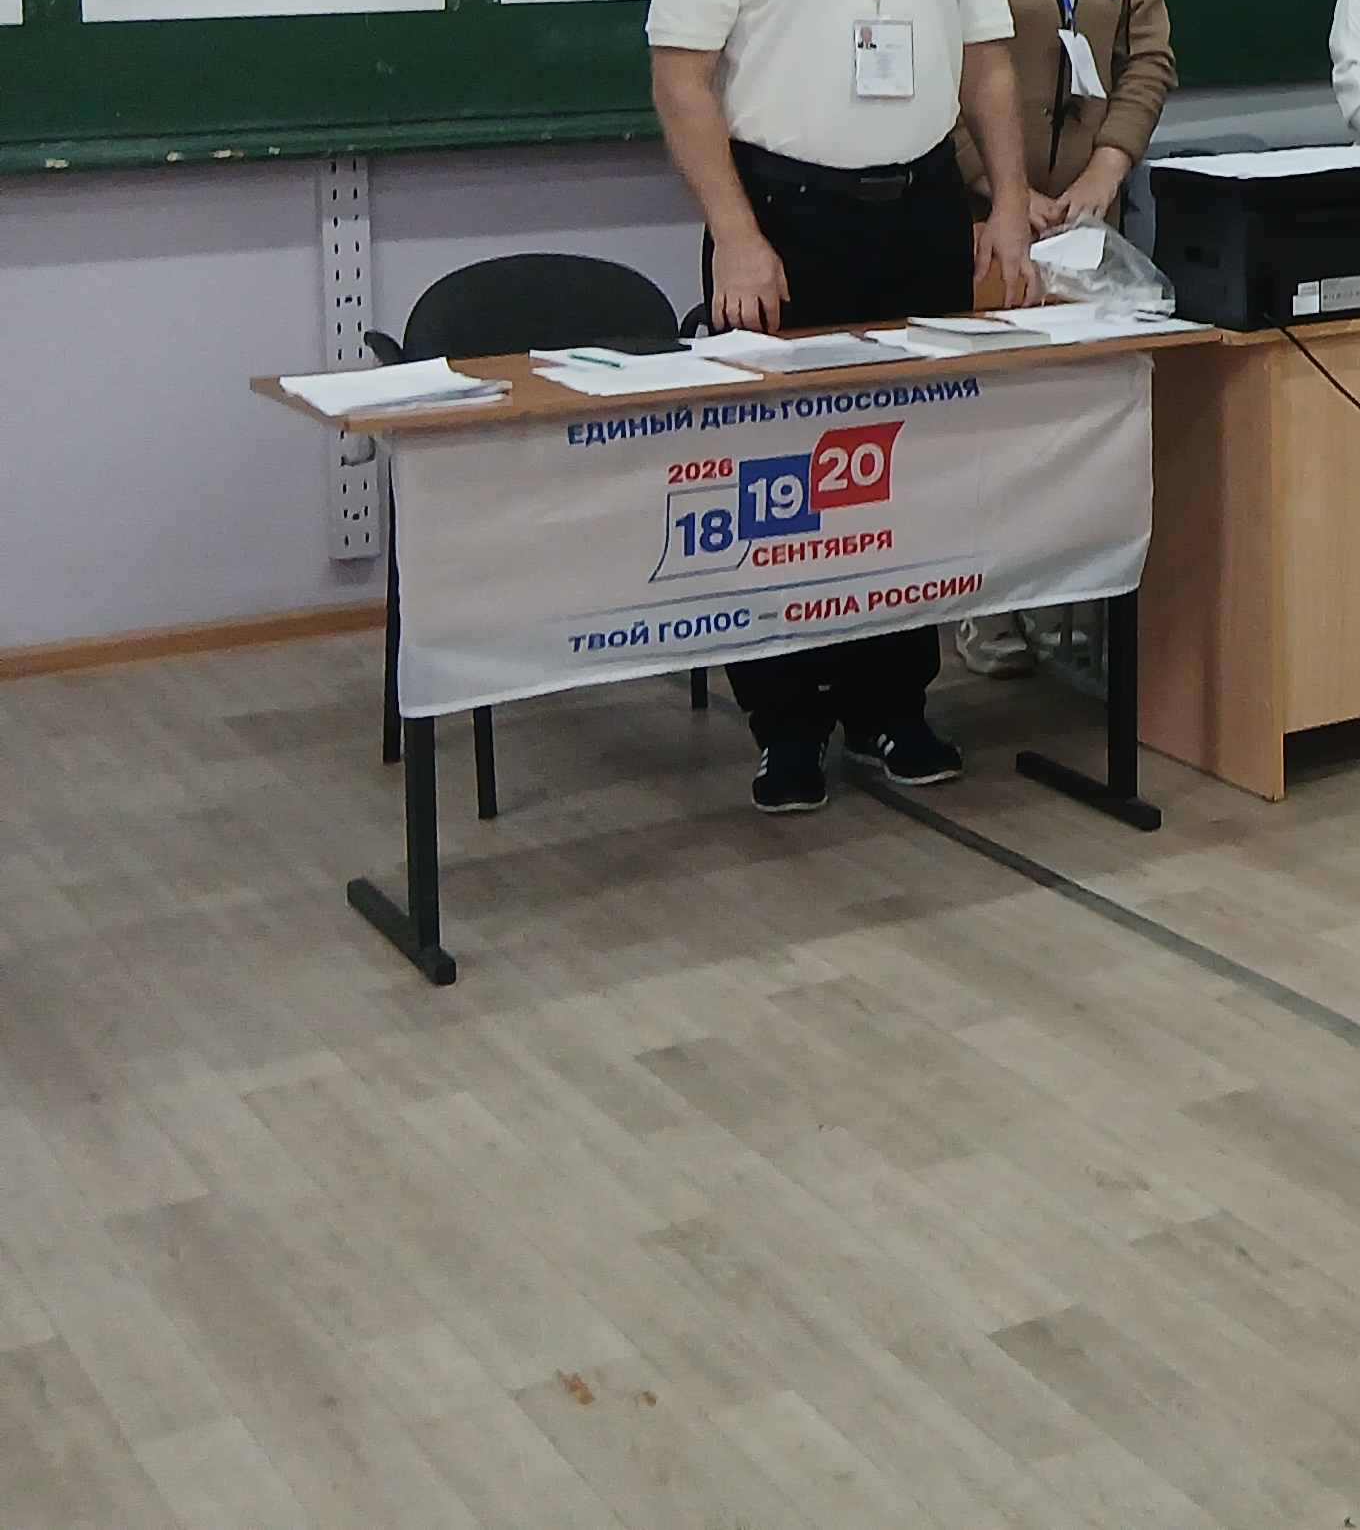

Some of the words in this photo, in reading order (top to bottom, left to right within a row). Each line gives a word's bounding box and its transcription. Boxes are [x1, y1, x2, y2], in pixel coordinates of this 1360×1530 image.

[567, 405, 694, 447] ЕДИНЫЙ
[700, 404, 776, 430] ДЕНЬ
[780, 377, 981, 421] ГОЛОСОВАНИЯ
[668, 458, 734, 485] 2026
[675, 508, 734, 557] 18
[747, 474, 804, 523] 19
[818, 442, 885, 493] 20
[752, 529, 893, 568] СЕНТЯБРЯ
[568, 620, 650, 654] ТВОЙ
[658, 608, 751, 644] ГОЛОС
[785, 594, 860, 623] СИЛА
[868, 573, 983, 612] РОССИИ!
